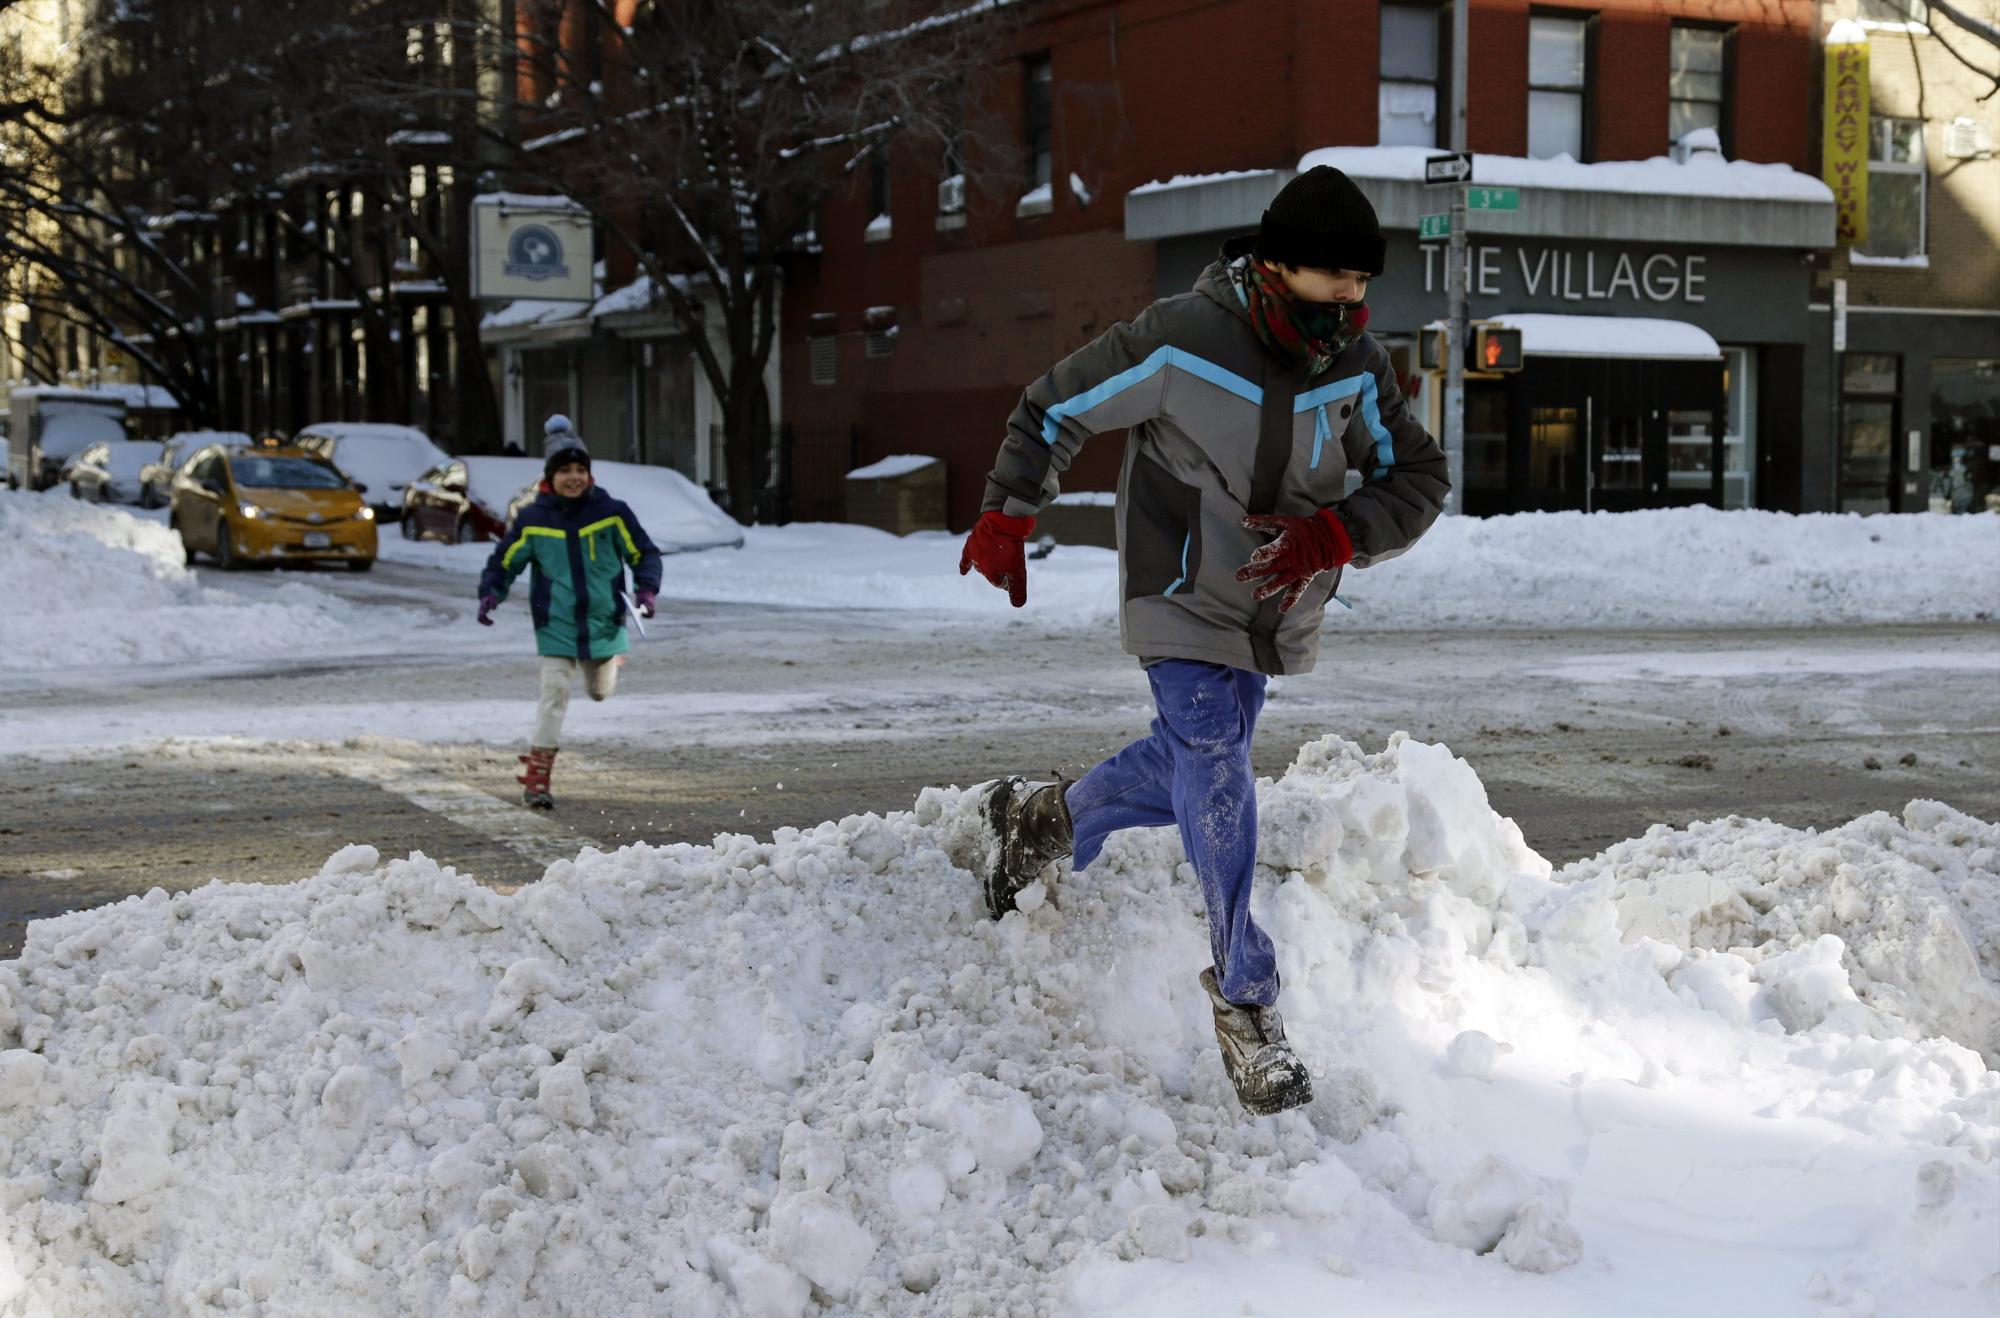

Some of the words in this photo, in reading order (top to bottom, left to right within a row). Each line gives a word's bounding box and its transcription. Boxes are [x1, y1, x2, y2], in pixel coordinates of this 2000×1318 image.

[1835, 43, 1862, 155] PHARMACY
[1481, 189, 1490, 208] 3
[1835, 160, 1858, 238] WITHIN
[1419, 244, 1501, 294] THE
[1517, 247, 1707, 302] VILLAGE
